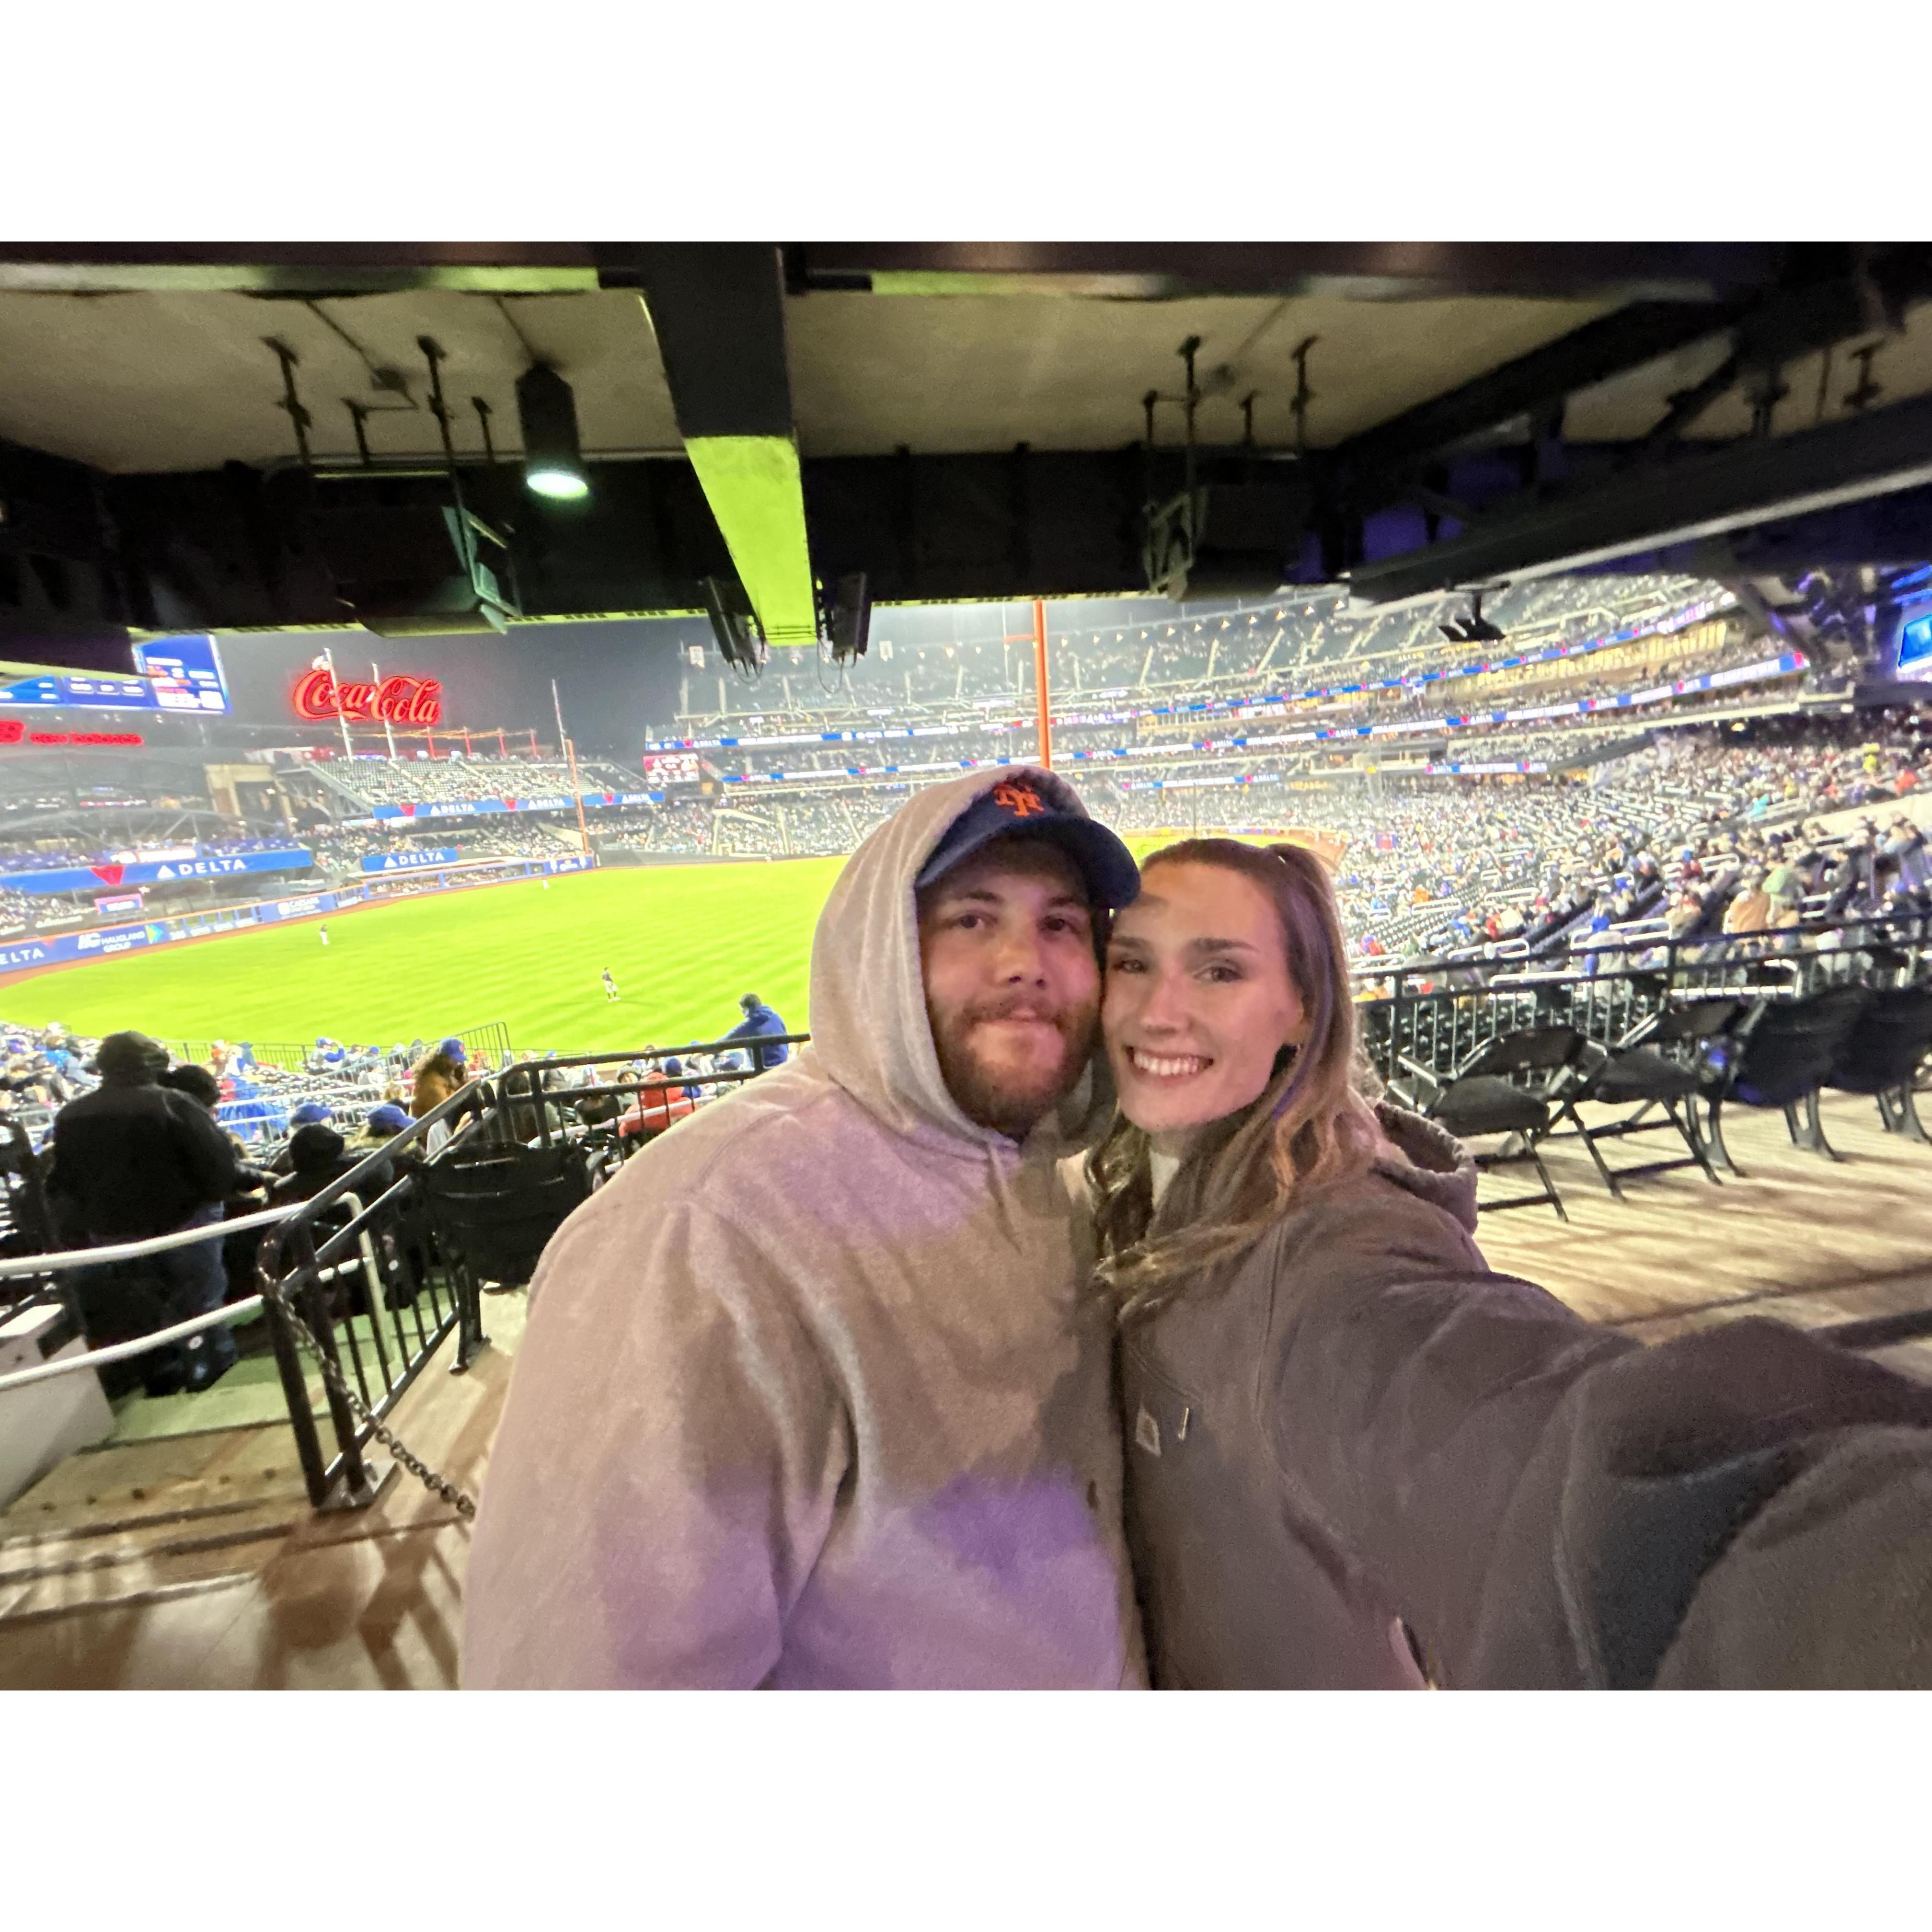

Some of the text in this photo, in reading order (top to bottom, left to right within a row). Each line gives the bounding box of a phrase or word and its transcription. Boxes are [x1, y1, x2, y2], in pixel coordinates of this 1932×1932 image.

[441, 804, 475, 814] DELTA
[398, 852, 444, 865] DELTA
[178, 859, 246, 875] DELTA
[0, 948, 44, 965] ELTA
